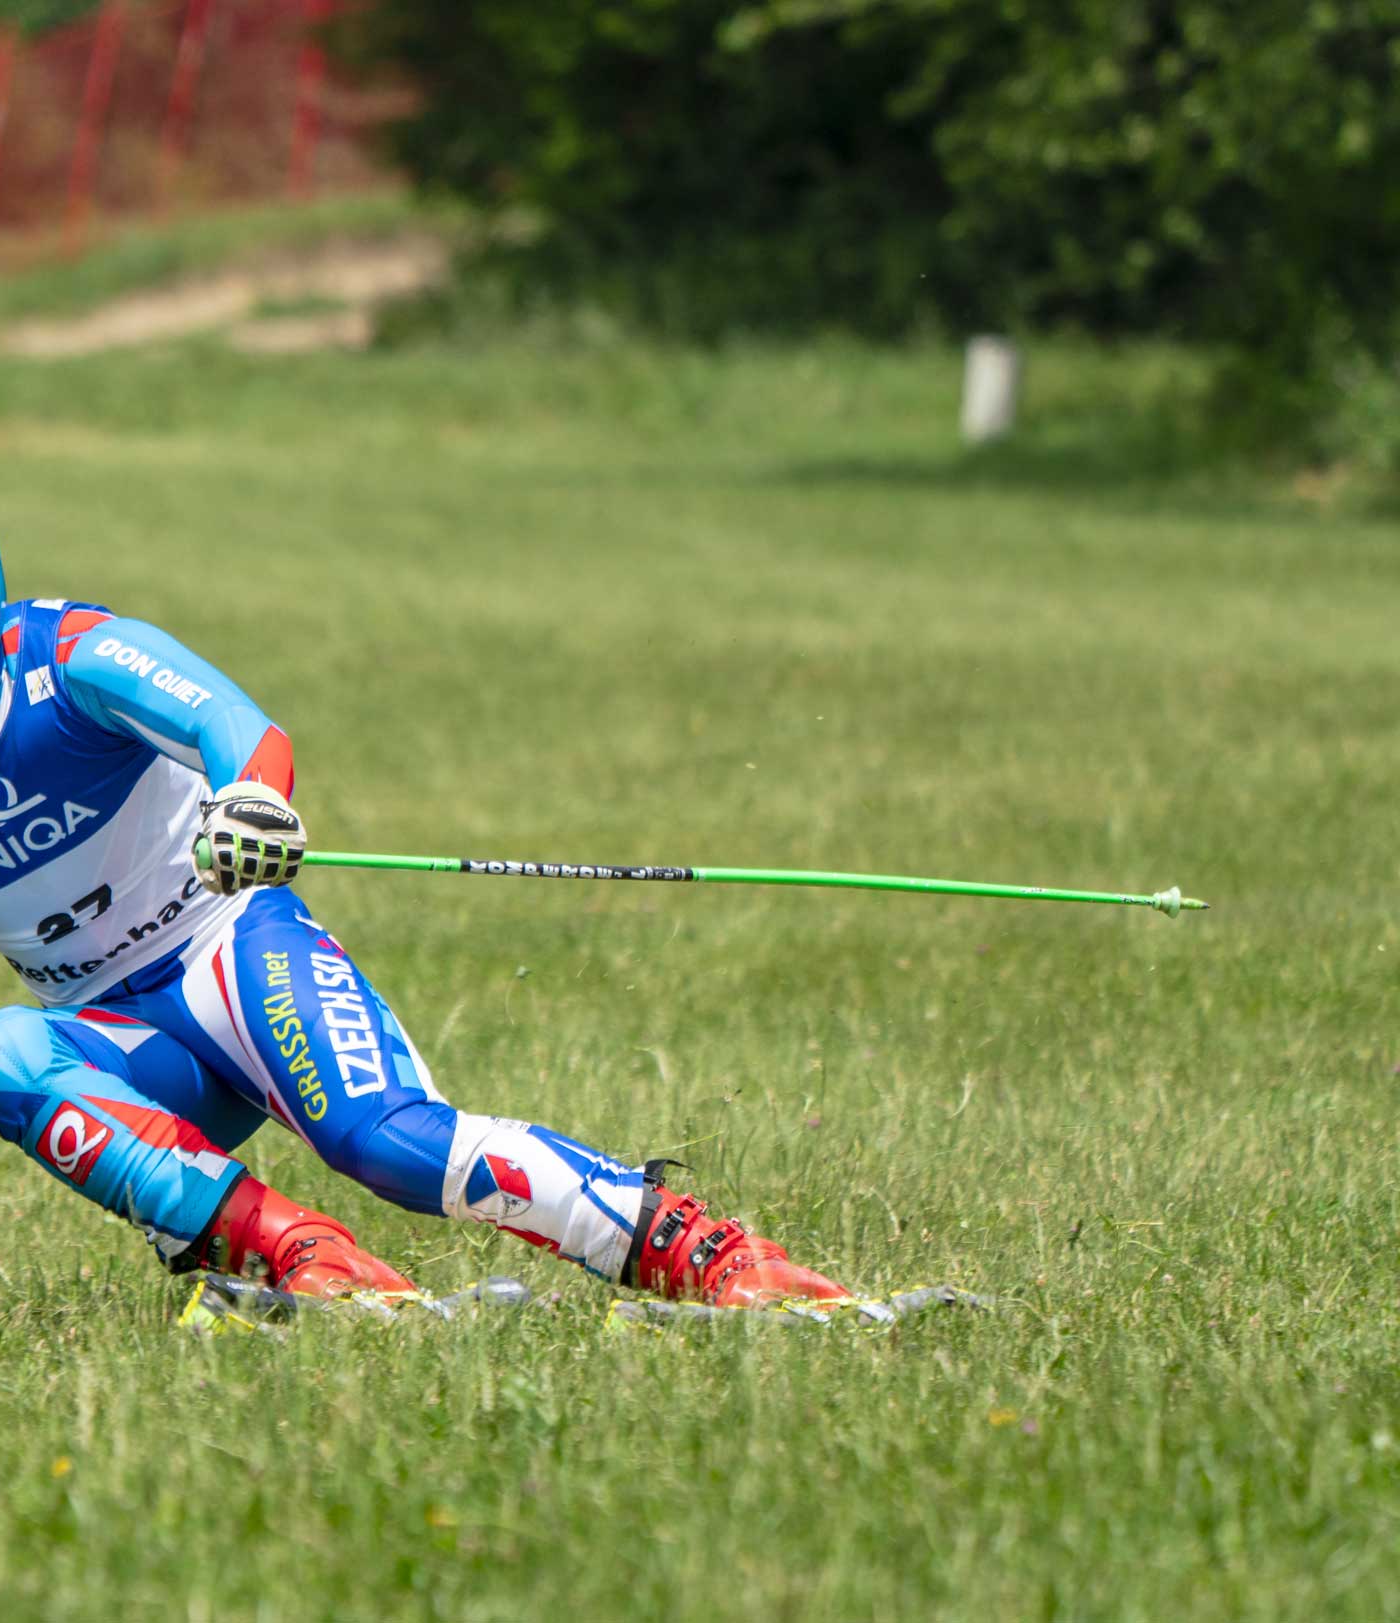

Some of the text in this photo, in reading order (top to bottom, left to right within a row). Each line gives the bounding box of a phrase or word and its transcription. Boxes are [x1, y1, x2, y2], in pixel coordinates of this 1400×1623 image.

[93, 637, 213, 710] DON QUIET
[232, 801, 295, 825] reusch
[3, 876, 203, 985] Rettenbac
[37, 883, 112, 945] 27
[261, 951, 328, 1122] GRASSKI.net
[317, 991, 387, 1099] CZECH
